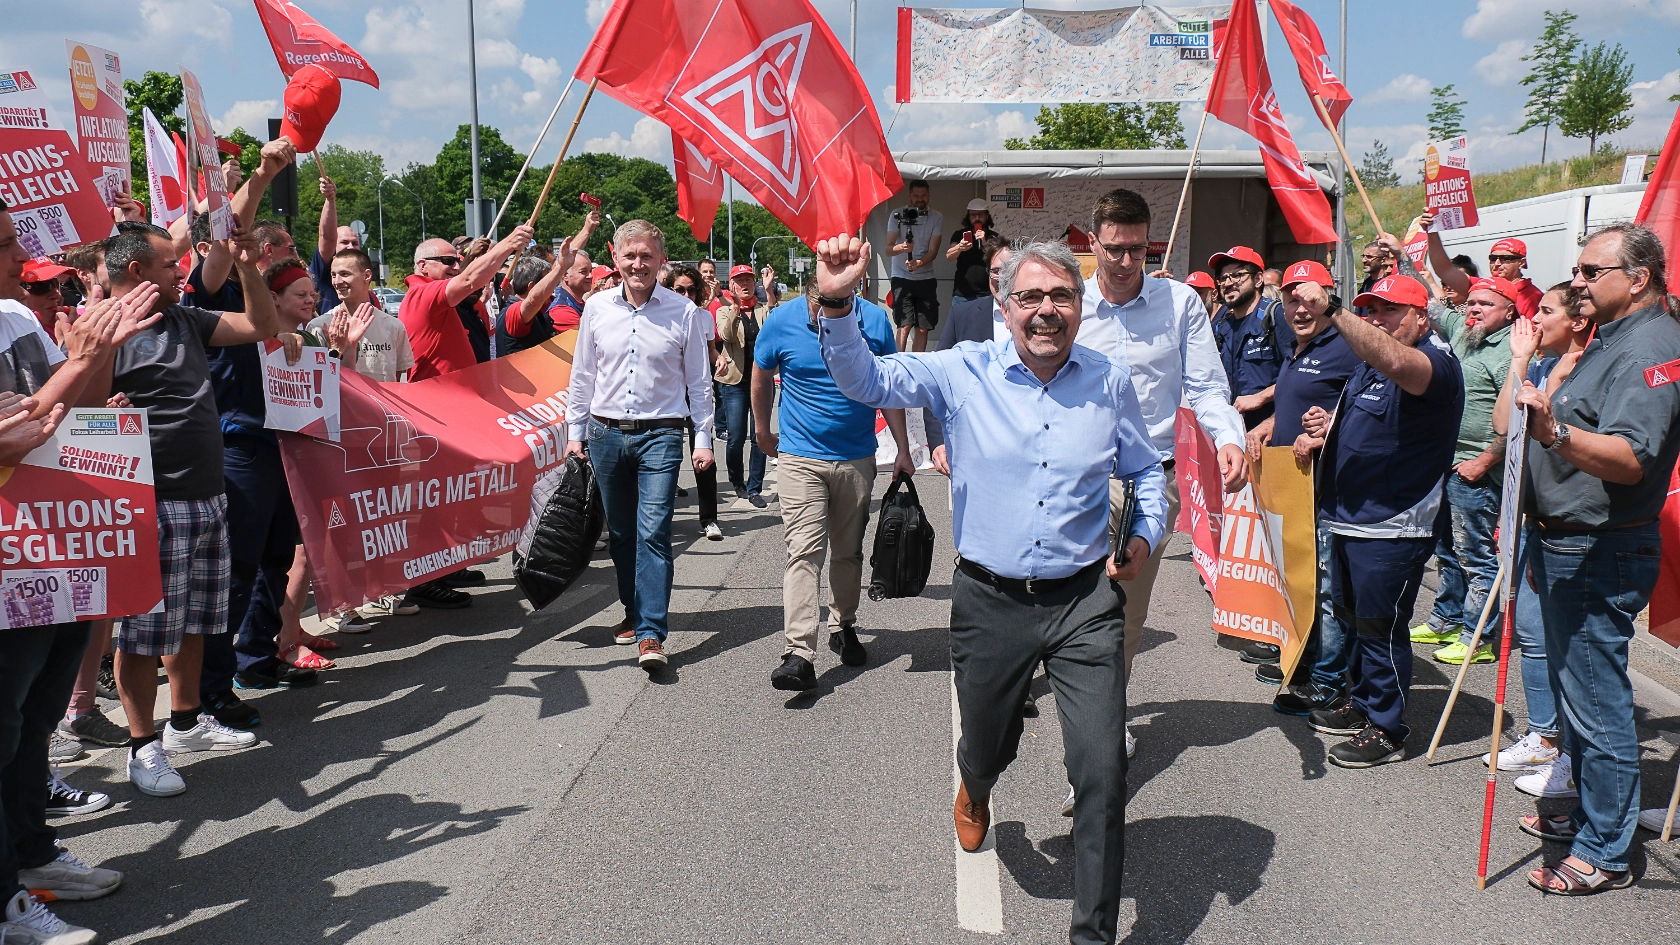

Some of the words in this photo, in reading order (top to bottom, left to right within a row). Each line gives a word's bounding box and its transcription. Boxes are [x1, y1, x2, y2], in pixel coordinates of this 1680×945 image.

[1181, 22, 1206, 32] GUTE
[1153, 35, 1187, 45] ARBEIT
[1188, 34, 1206, 45] FÜR
[285, 50, 365, 70] Regensburg
[1183, 49, 1207, 58] ALLE
[0, 106, 38, 117] IDARITÄT
[80, 115, 128, 141] INFLATIONS-
[87, 140, 129, 163] AUSGLEICH
[1426, 176, 1469, 196] INFLATIONS-
[1428, 190, 1469, 209] AUSGLEICH
[361, 342, 392, 354] Angels
[266, 365, 311, 383] SOLIDARITÄT
[268, 378, 312, 400] GEWINNT
[60, 445, 129, 466] SOLIDARITÄT
[58, 455, 127, 478] GEWINNT
[350, 483, 411, 523] TEAM
[418, 478, 440, 510] IG
[445, 463, 518, 504] METALL
[2, 529, 137, 565] SGLEICH
[361, 519, 410, 562] BMW
[403, 545, 469, 580] GEMEINSAM
[468, 535, 491, 559] FÜR
[66, 568, 100, 583] 1500
[15, 575, 59, 600] 1500
